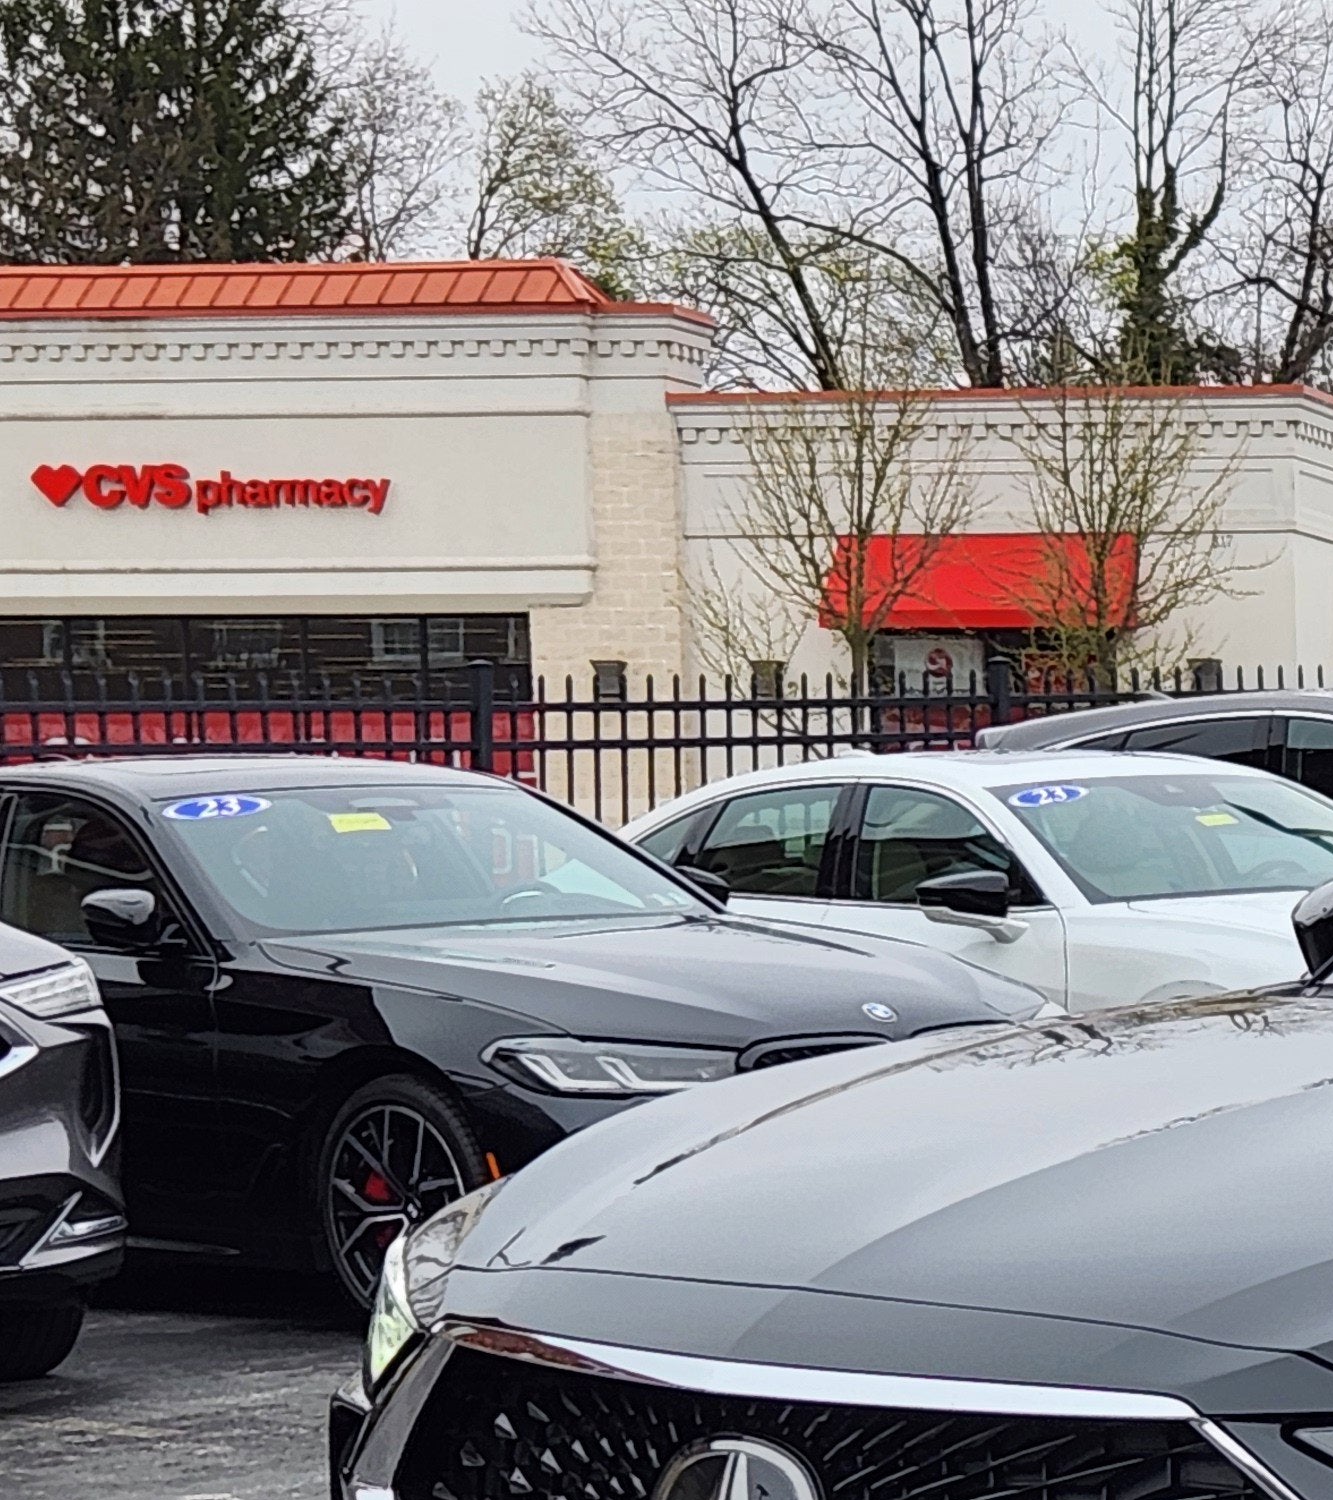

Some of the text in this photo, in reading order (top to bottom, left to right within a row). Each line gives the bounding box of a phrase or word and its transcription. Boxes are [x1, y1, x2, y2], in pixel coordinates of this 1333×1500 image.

[81, 463, 391, 516] CVS pharmacy
[197, 797, 242, 818] 23
